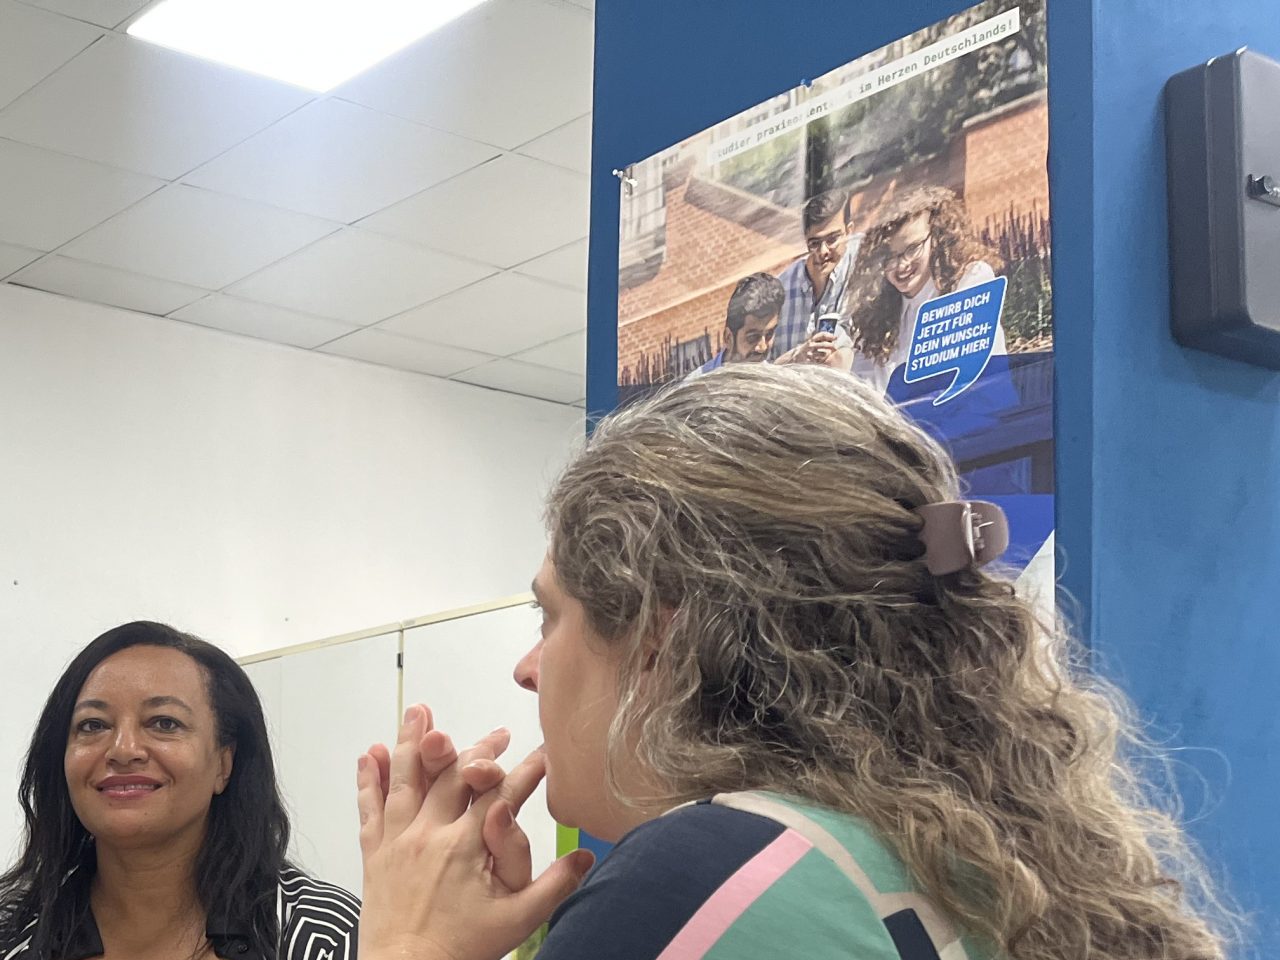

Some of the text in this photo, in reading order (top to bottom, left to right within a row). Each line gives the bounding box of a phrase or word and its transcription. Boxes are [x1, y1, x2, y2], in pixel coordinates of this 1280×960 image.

[712, 136, 751, 159] tudier
[859, 82, 872, 94] im
[877, 63, 918, 87] Herzen
[923, 19, 1013, 66] Deutschlands!
[921, 291, 991, 324] BEWIRB DICH
[914, 322, 992, 356] DEIN WUNSCH-
[917, 312, 973, 340] JETZT FÜR
[911, 337, 990, 371] STUDIUM HIER!
